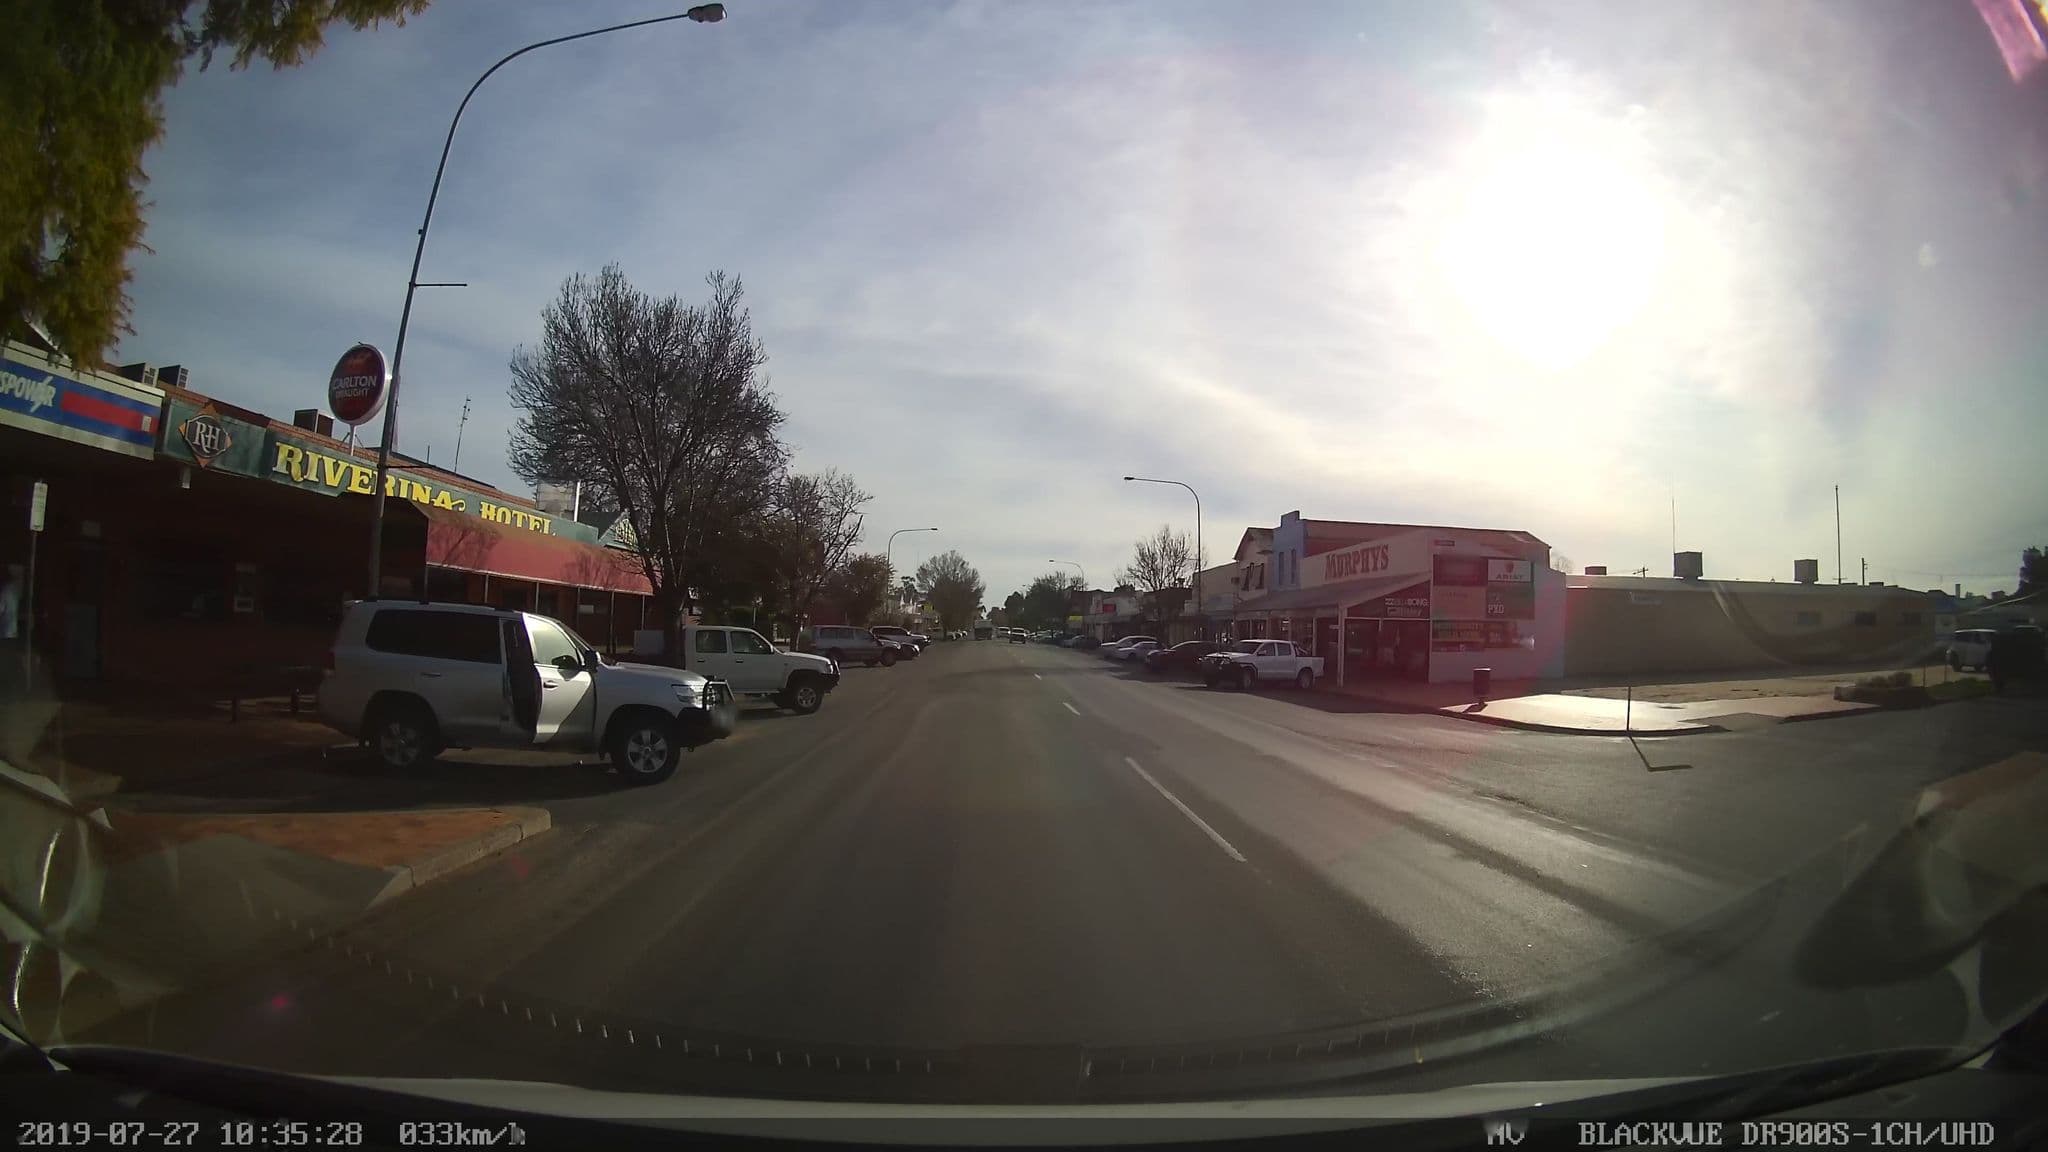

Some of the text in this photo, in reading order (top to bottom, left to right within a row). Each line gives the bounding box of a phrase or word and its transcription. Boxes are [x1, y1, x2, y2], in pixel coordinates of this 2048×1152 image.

[333, 375, 377, 390] CARLTON
[192, 420, 221, 454] RH
[272, 441, 466, 512] RIVERINA
[480, 501, 556, 536] HOTEL
[1324, 544, 1389, 580] MURPHYS
